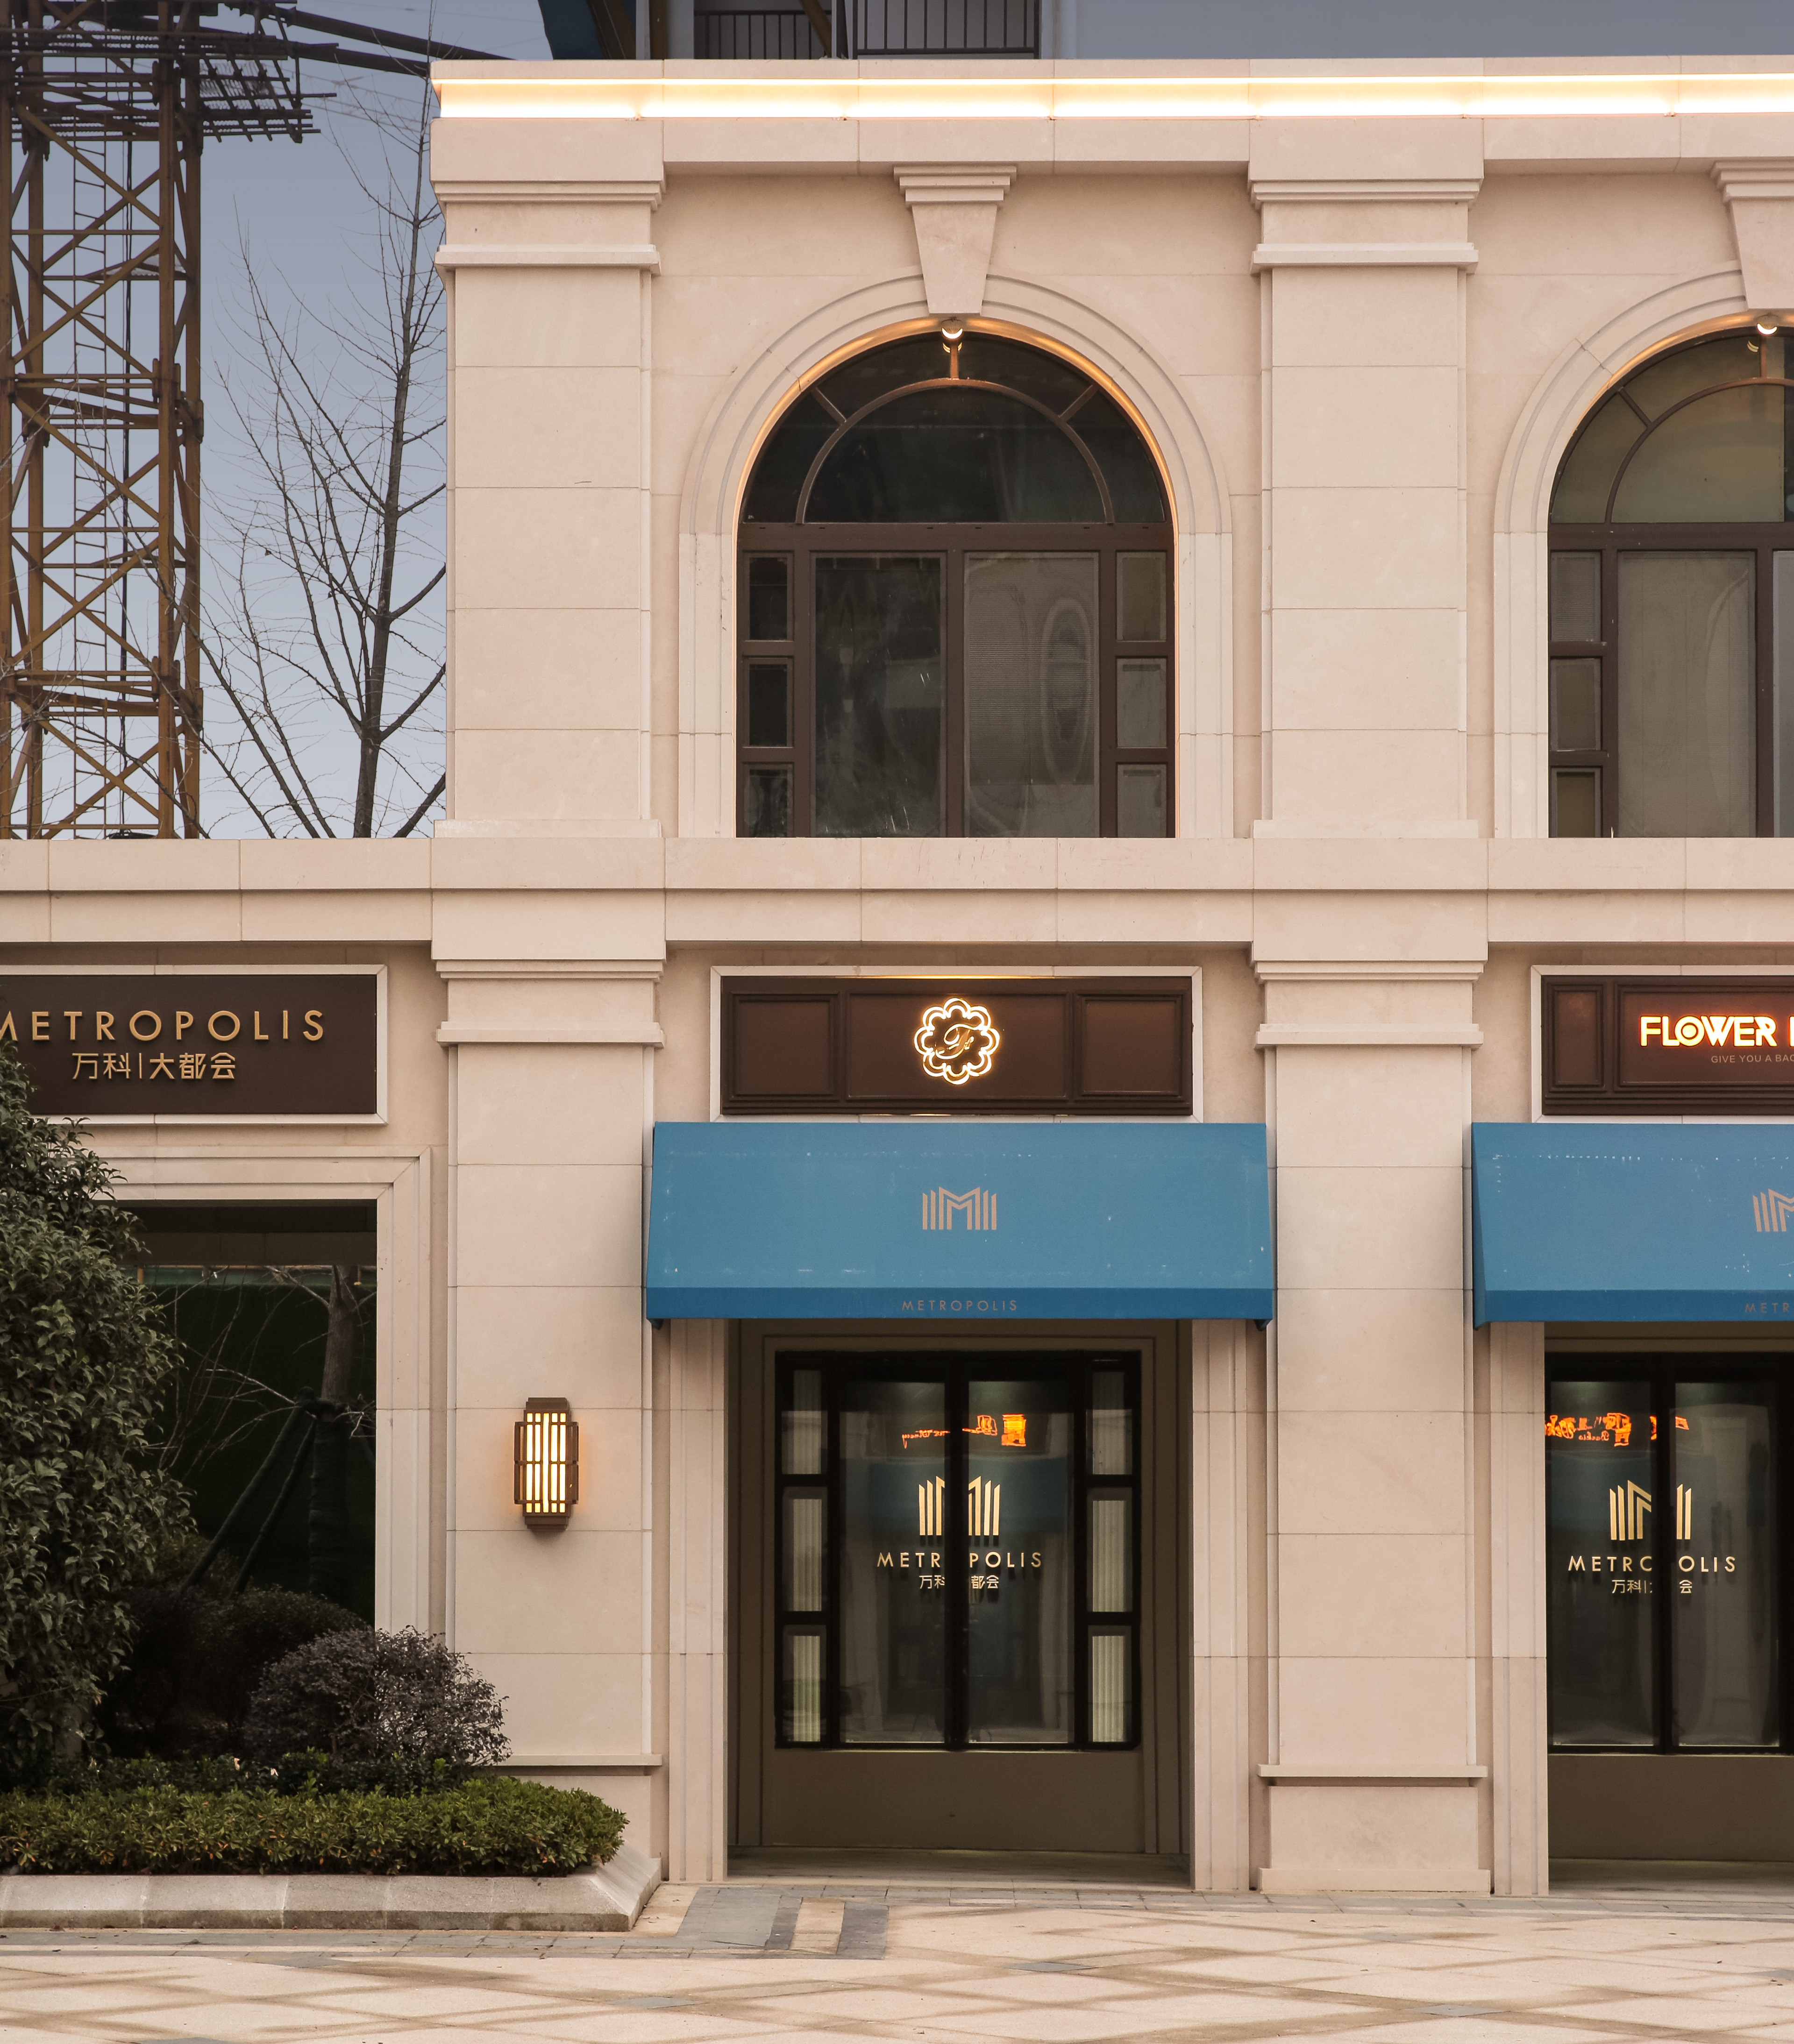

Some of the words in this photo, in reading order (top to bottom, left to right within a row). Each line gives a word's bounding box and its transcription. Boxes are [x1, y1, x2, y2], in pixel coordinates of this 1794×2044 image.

[1639, 1015, 1777, 1047] FLOWER
[1711, 1055, 1736, 1063] GIVE
[1739, 1054, 1762, 1063] YOU
[902, 1299, 1017, 1311] METROPOLIS
[877, 1551, 1041, 1568] METRPOLIS
[1568, 1555, 1736, 1573] METROOLIS
